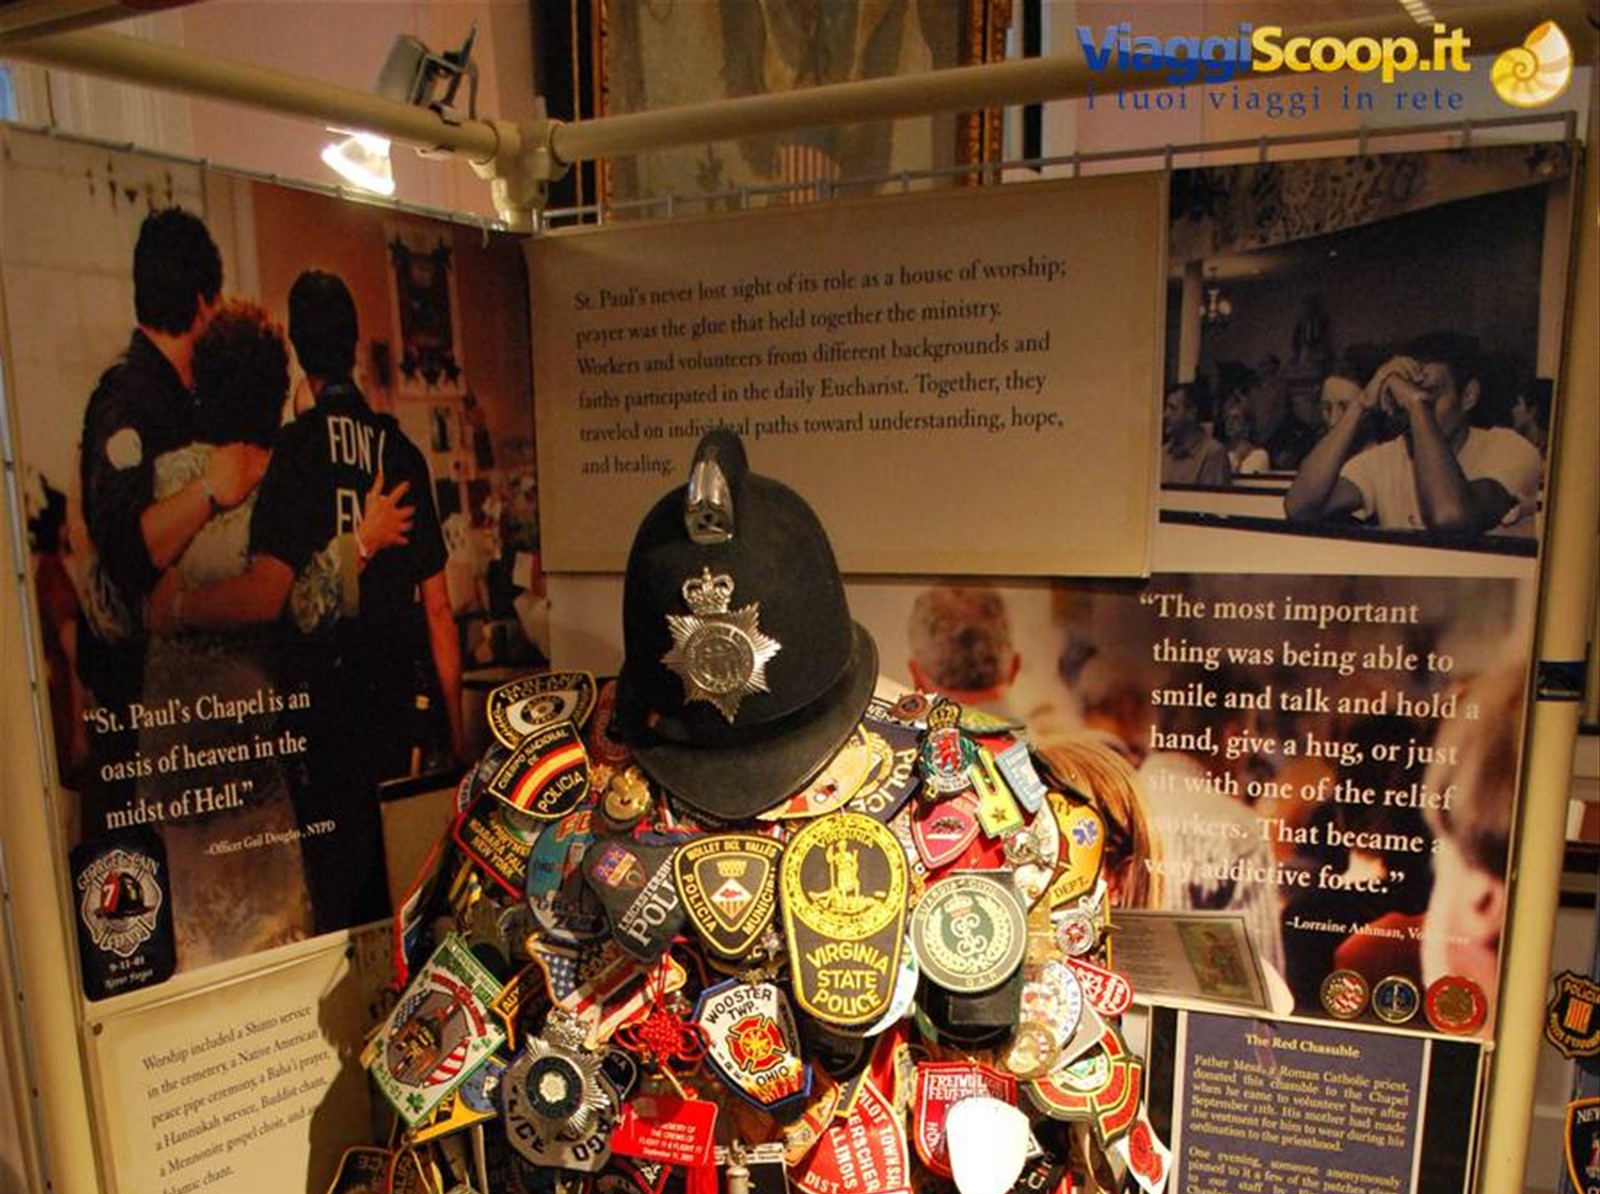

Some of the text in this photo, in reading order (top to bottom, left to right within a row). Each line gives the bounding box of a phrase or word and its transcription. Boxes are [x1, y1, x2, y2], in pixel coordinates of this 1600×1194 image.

[574, 256, 1066, 310] St. Paul's never lost sight of its role as a house of worship;
[576, 299, 1002, 348] prayer was the glue that held together the ministry.
[578, 331, 1051, 375] Workers and volunteers from different backgrounds and
[915, 369, 1047, 398] Together, they
[580, 406, 1063, 441] traveled on paths toward understanding, hope,
[582, 453, 675, 478] and healing.
[1213, 597, 1276, 620] most
[1285, 596, 1419, 628] important
[1153, 639, 1454, 675] thing was being able to
[130, 699, 191, 729] Paul's
[195, 689, 263, 724] Chapel
[268, 689, 284, 712] is
[289, 690, 310, 710] an
[1151, 684, 1479, 720] smile and talk and hold a
[101, 730, 308, 782] oasis of heaven in the
[1150, 725, 1458, 770] hand, give a hug, or just
[537, 771, 585, 812] POLICIA
[1184, 770, 1456, 811] with one of the relief
[106, 801, 164, 830] midst
[170, 790, 192, 817] of
[307, 819, 336, 836] NYPD
[1258, 818, 1423, 853] That became
[1203, 858, 1310, 887] addictive
[102, 883, 116, 907] 7
[683, 873, 718, 933] POLICIA
[805, 943, 891, 976] VIRGINIA
[816, 969, 878, 990] STATE
[704, 986, 773, 1025] WOOSTER
[726, 1000, 760, 1021] TWP.
[812, 989, 882, 1017] POLICE
[143, 1049, 189, 1071] Worship
[191, 1029, 235, 1056] included
[279, 1006, 313, 1023] service
[1245, 1033, 1361, 1059] The Red Chasuble
[755, 1065, 790, 1087] OHIO
[1279, 1065, 1369, 1088] Roman Catholic
